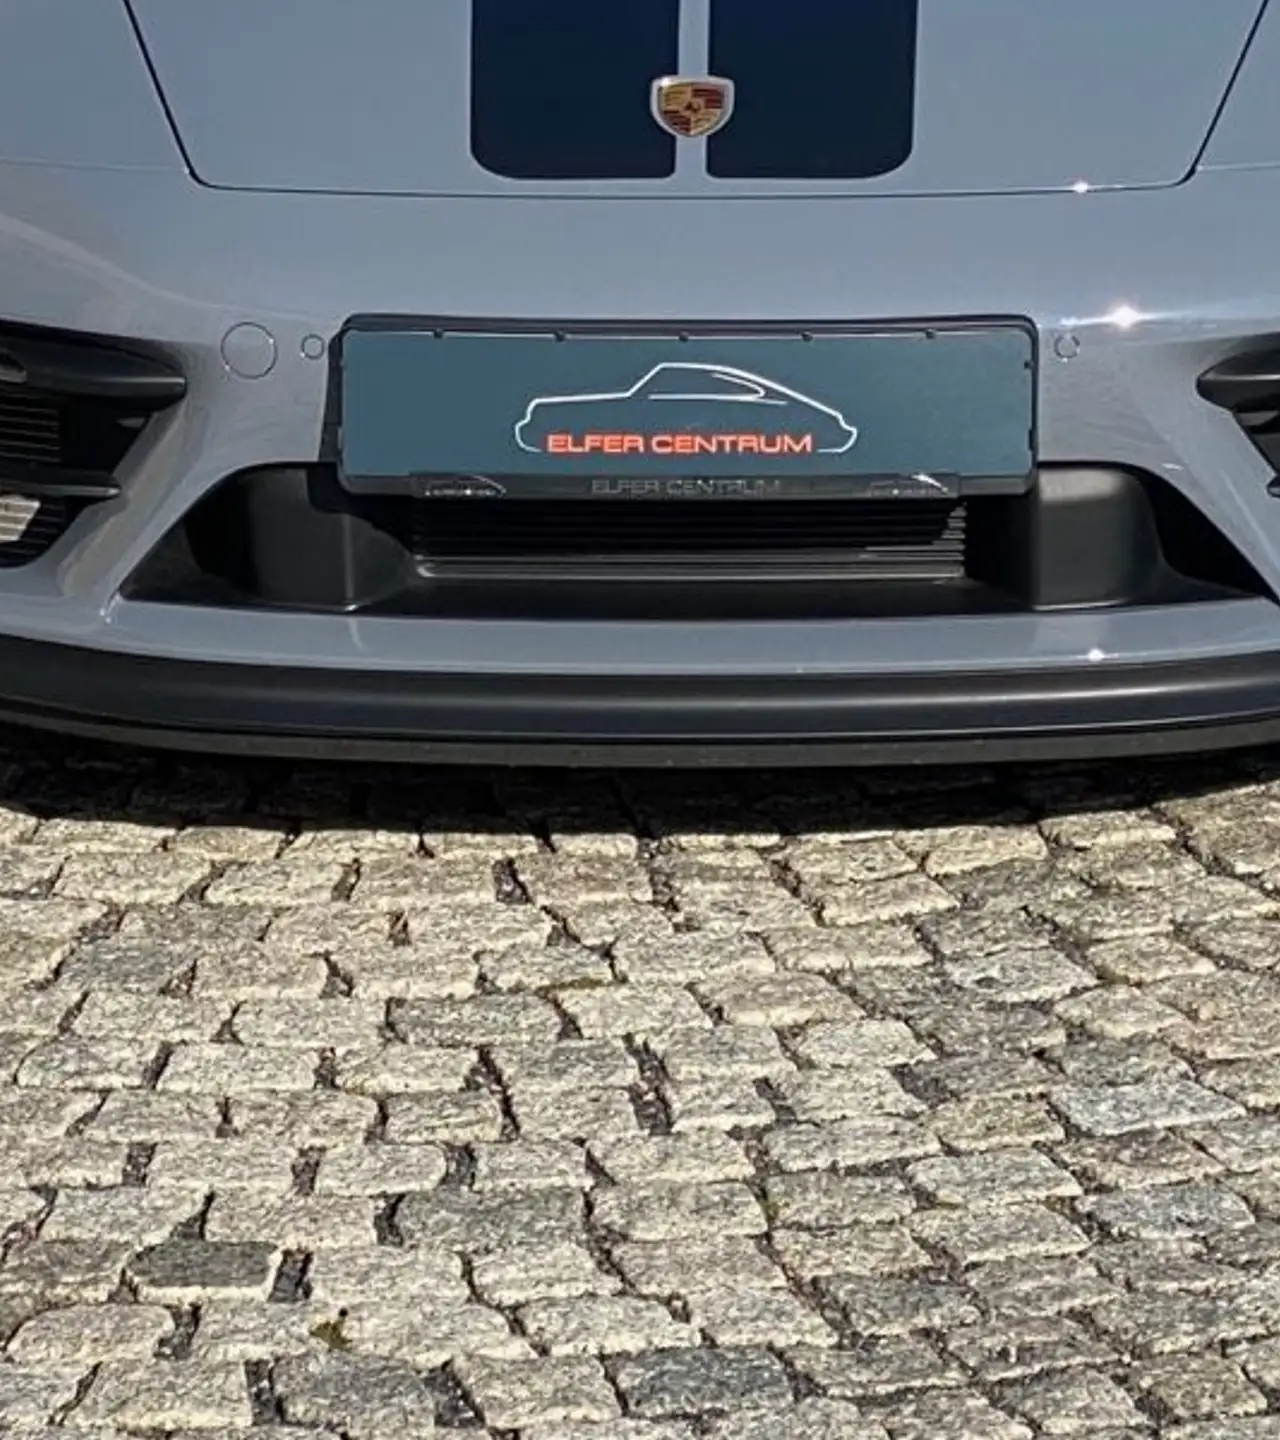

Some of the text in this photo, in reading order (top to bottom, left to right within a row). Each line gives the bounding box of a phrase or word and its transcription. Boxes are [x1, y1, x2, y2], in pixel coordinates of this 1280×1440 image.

[546, 433, 813, 454] ELFER CENTRUM
[591, 479, 781, 495] ELFER CENTRUM
